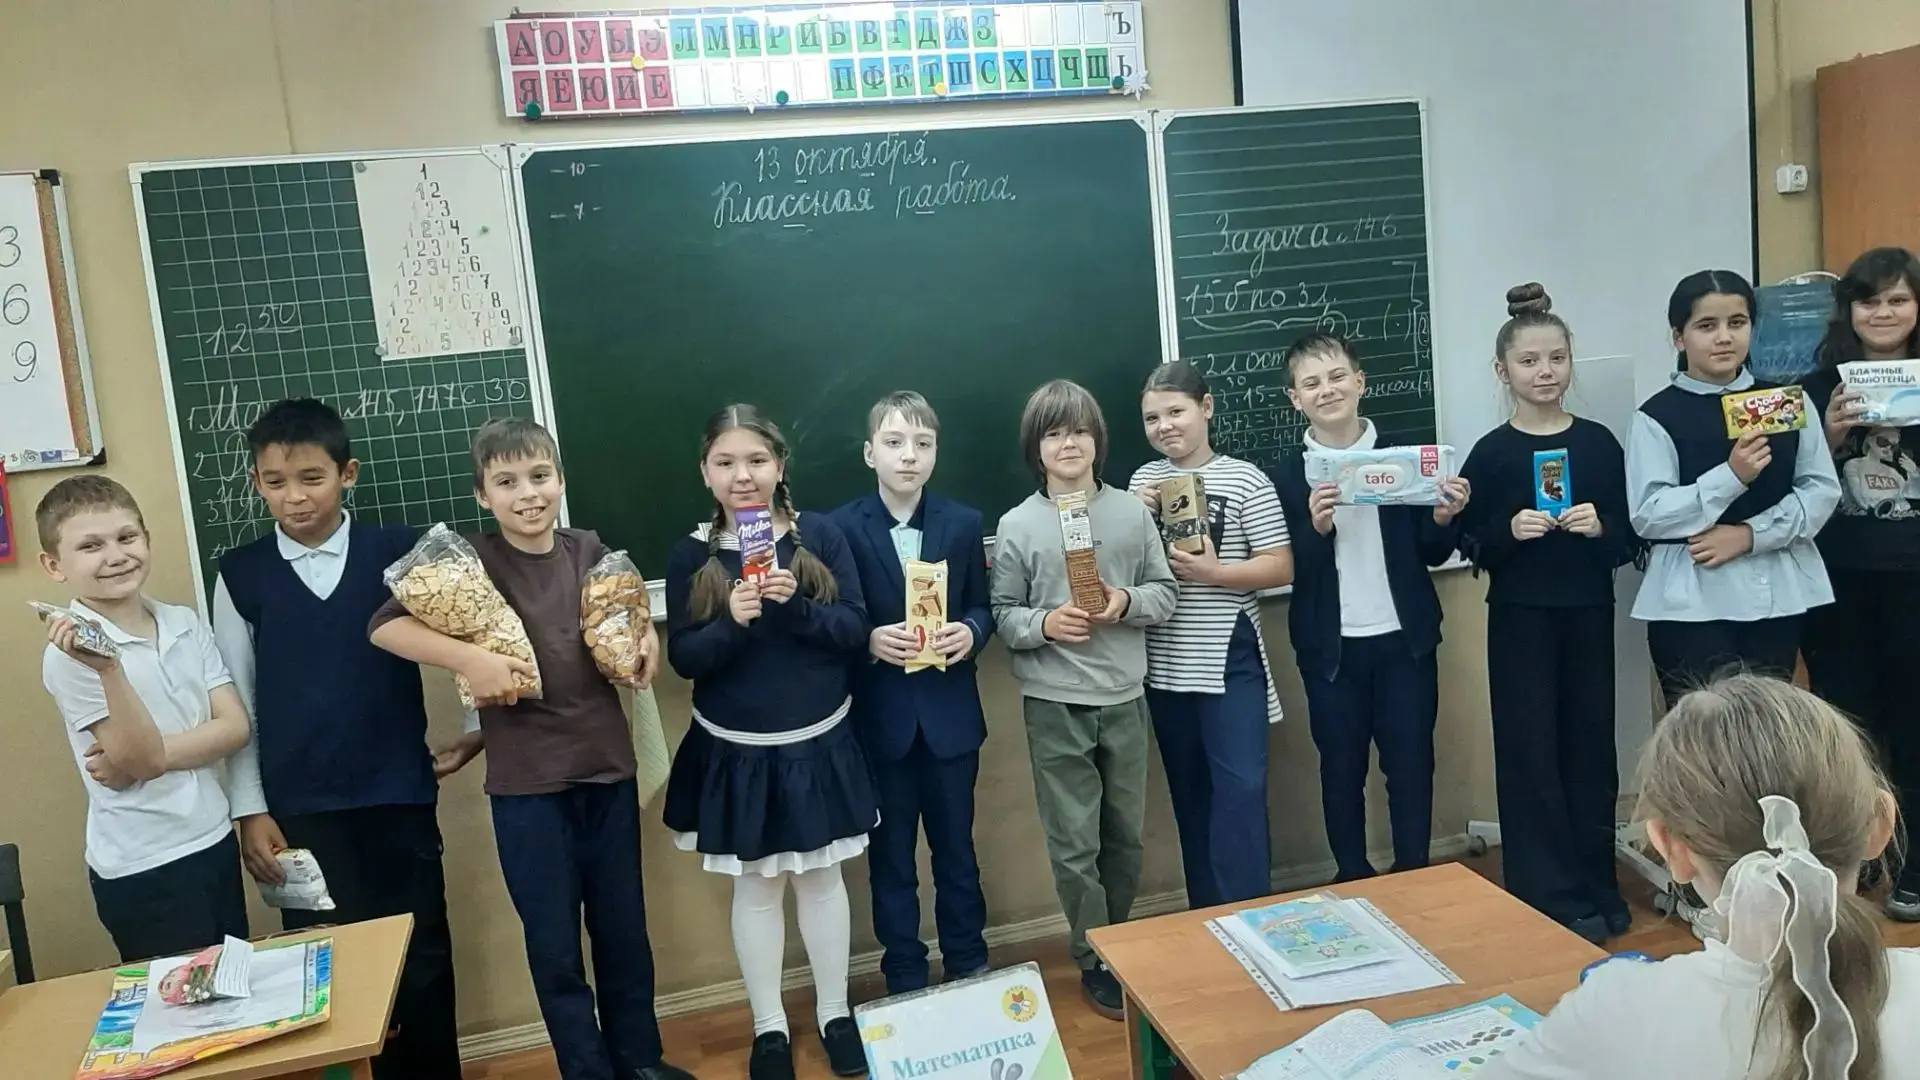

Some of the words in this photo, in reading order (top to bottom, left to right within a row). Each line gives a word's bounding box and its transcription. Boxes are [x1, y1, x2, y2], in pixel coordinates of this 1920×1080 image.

[514, 29, 536, 58] А
[579, 29, 598, 55] У
[606, 28, 635, 53] Ы
[675, 26, 697, 53] Л
[707, 26, 731, 51] М
[862, 20, 878, 45] В
[918, 17, 938, 49] Д
[945, 16, 968, 42] Ж
[580, 76, 609, 102] Ю
[833, 66, 856, 92] П
[863, 64, 884, 91] Ф
[949, 60, 972, 85] Ш
[1062, 56, 1082, 81] Ч
[1087, 54, 1111, 84] Щ
[421, 162, 427, 180] 1
[754, 145, 780, 183] 13
[430, 181, 441, 199] 2
[440, 199, 450, 217] 3
[711, 180, 875, 229] Классная
[449, 219, 460, 236] 4
[460, 237, 470, 255] 5
[1212, 212, 1329, 278] Задача
[469, 255, 481, 273] 6
[407, 279, 419, 296] 2
[3, 283, 30, 325] 6
[491, 291, 501, 309] 8
[399, 317, 411, 335] 2
[500, 308, 511, 326] 9
[206, 322, 251, 355] 12
[13, 341, 37, 382] 9
[1848, 373, 1917, 385] ПОЛОТЕНЦА
[1745, 392, 1783, 409] Choco
[1365, 474, 1396, 485] tafo
[738, 519, 772, 540] Milka
[890, 1030, 1037, 1080] Математика
